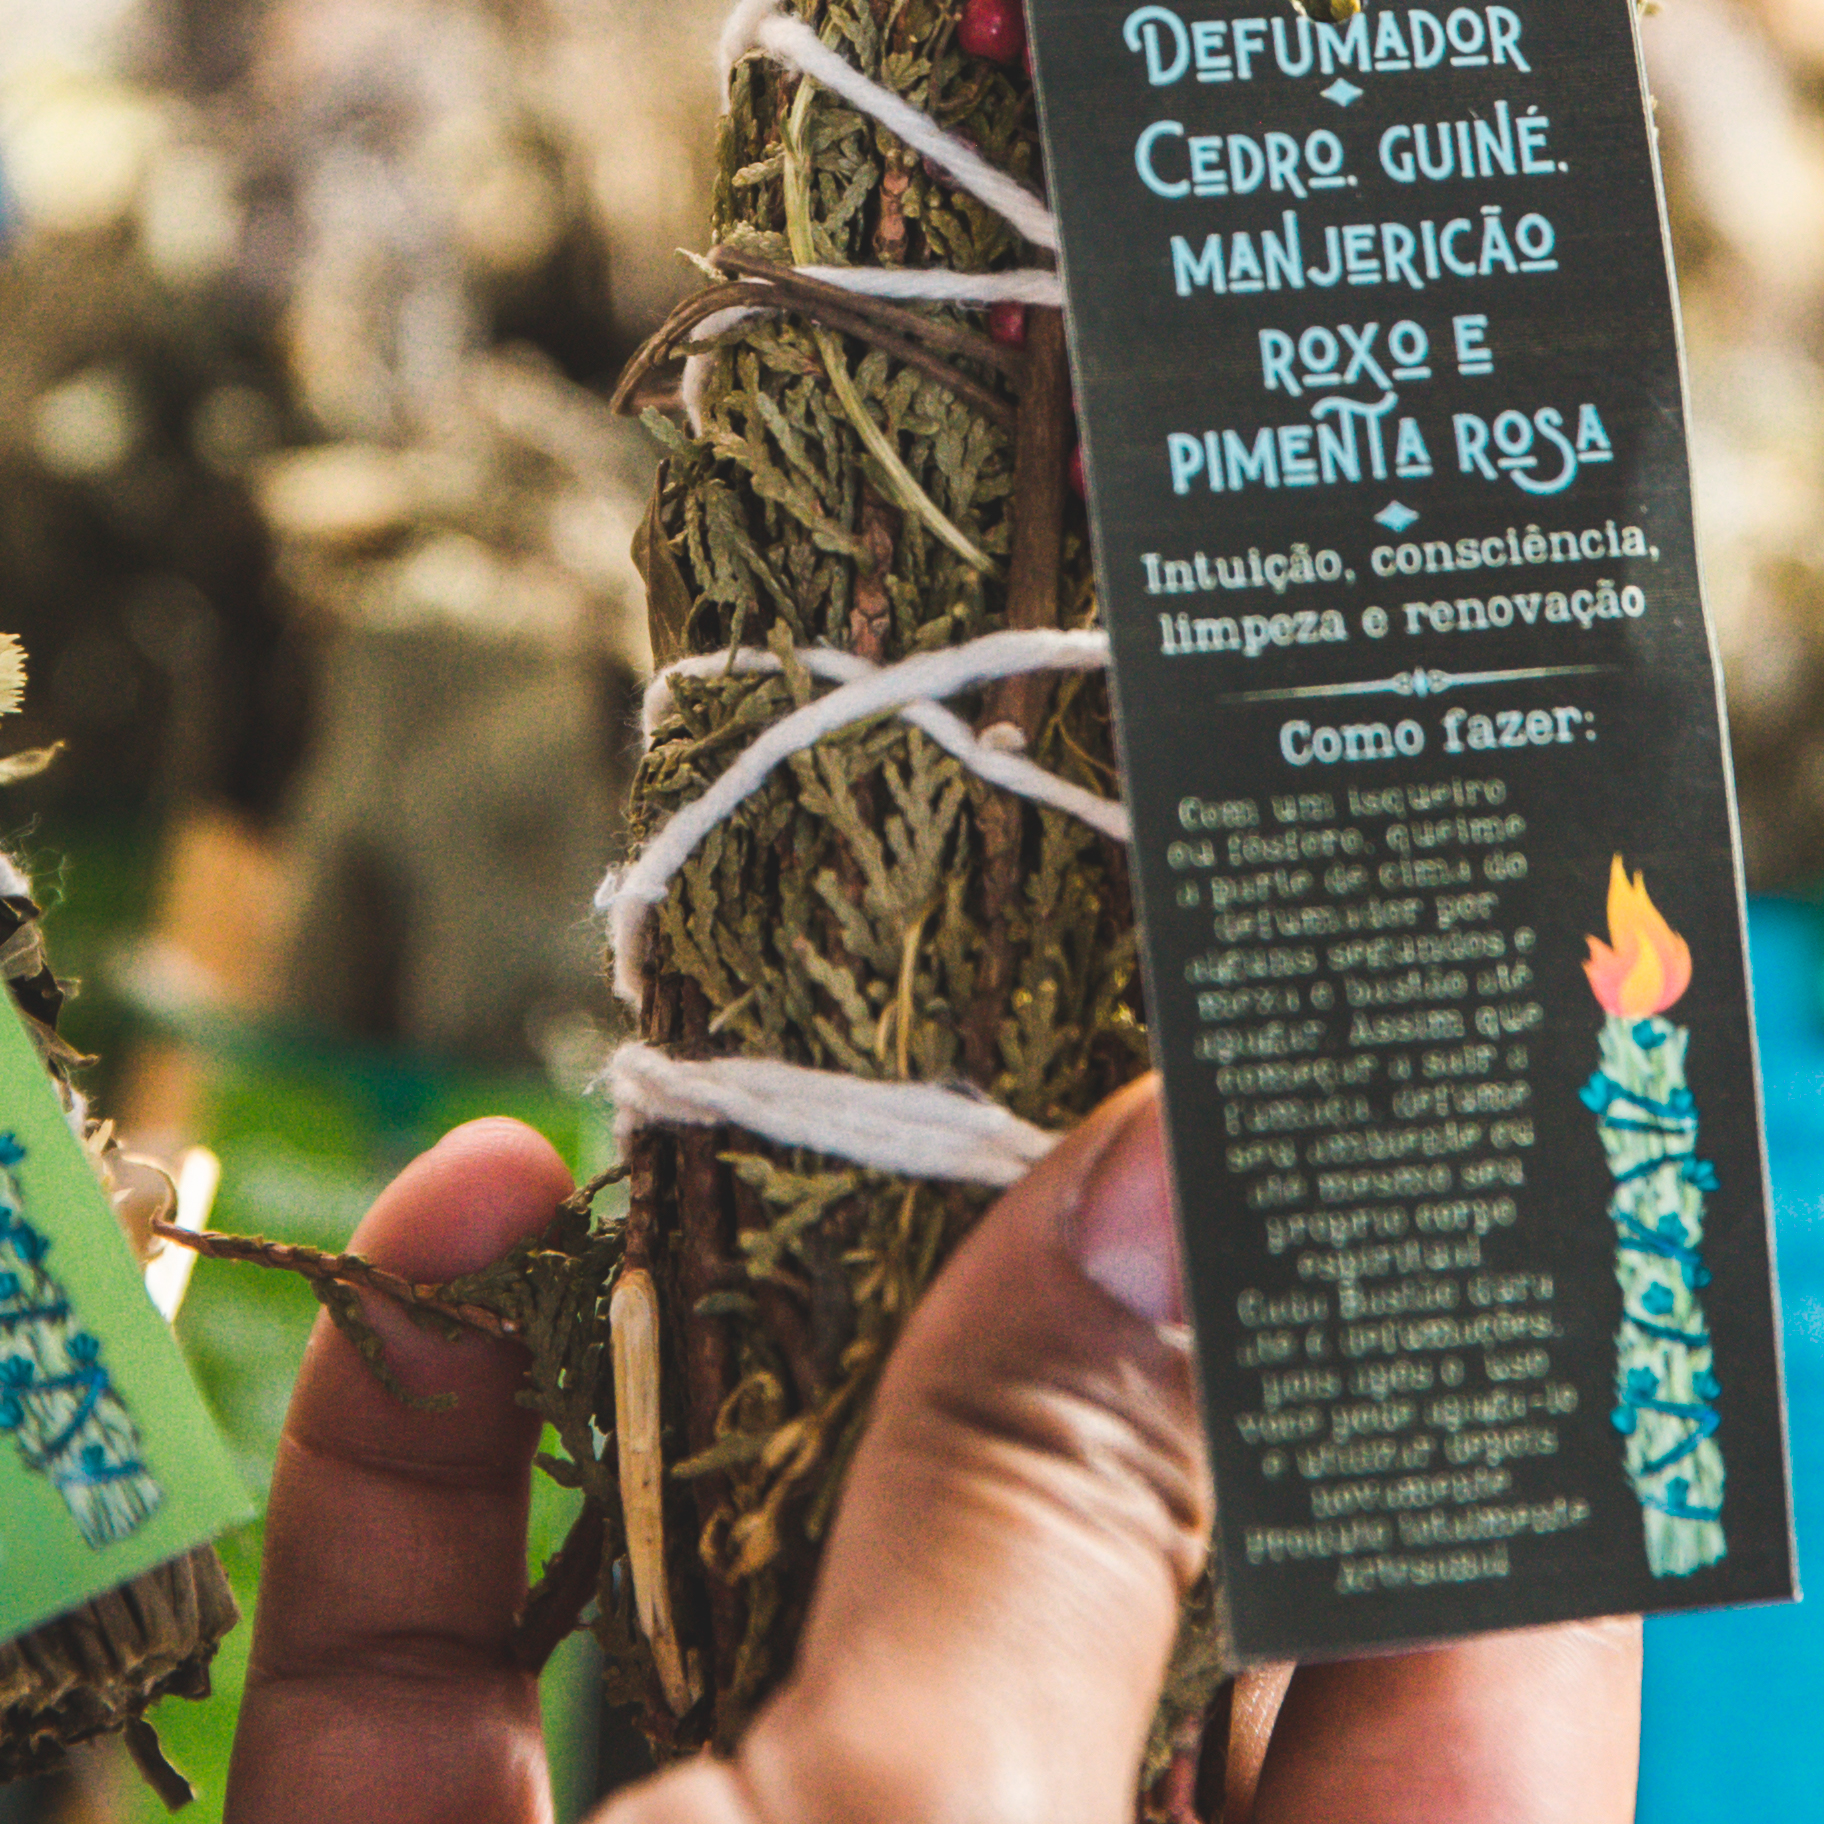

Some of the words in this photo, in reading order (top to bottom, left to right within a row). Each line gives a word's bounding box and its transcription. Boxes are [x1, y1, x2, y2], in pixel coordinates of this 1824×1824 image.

[1121, 4, 1531, 87] DEFUMADOR
[1171, 205, 1556, 295] MANJERICÃO
[1258, 319, 1430, 396] ROXO
[1452, 313, 1493, 375] E
[1165, 391, 1434, 494] PIMENTA
[1452, 403, 1612, 494] ROSA
[1159, 609, 1347, 657] limpeza
[1360, 604, 1388, 638] e
[1403, 578, 1646, 634] renovação
[1278, 718, 1425, 765] Como
